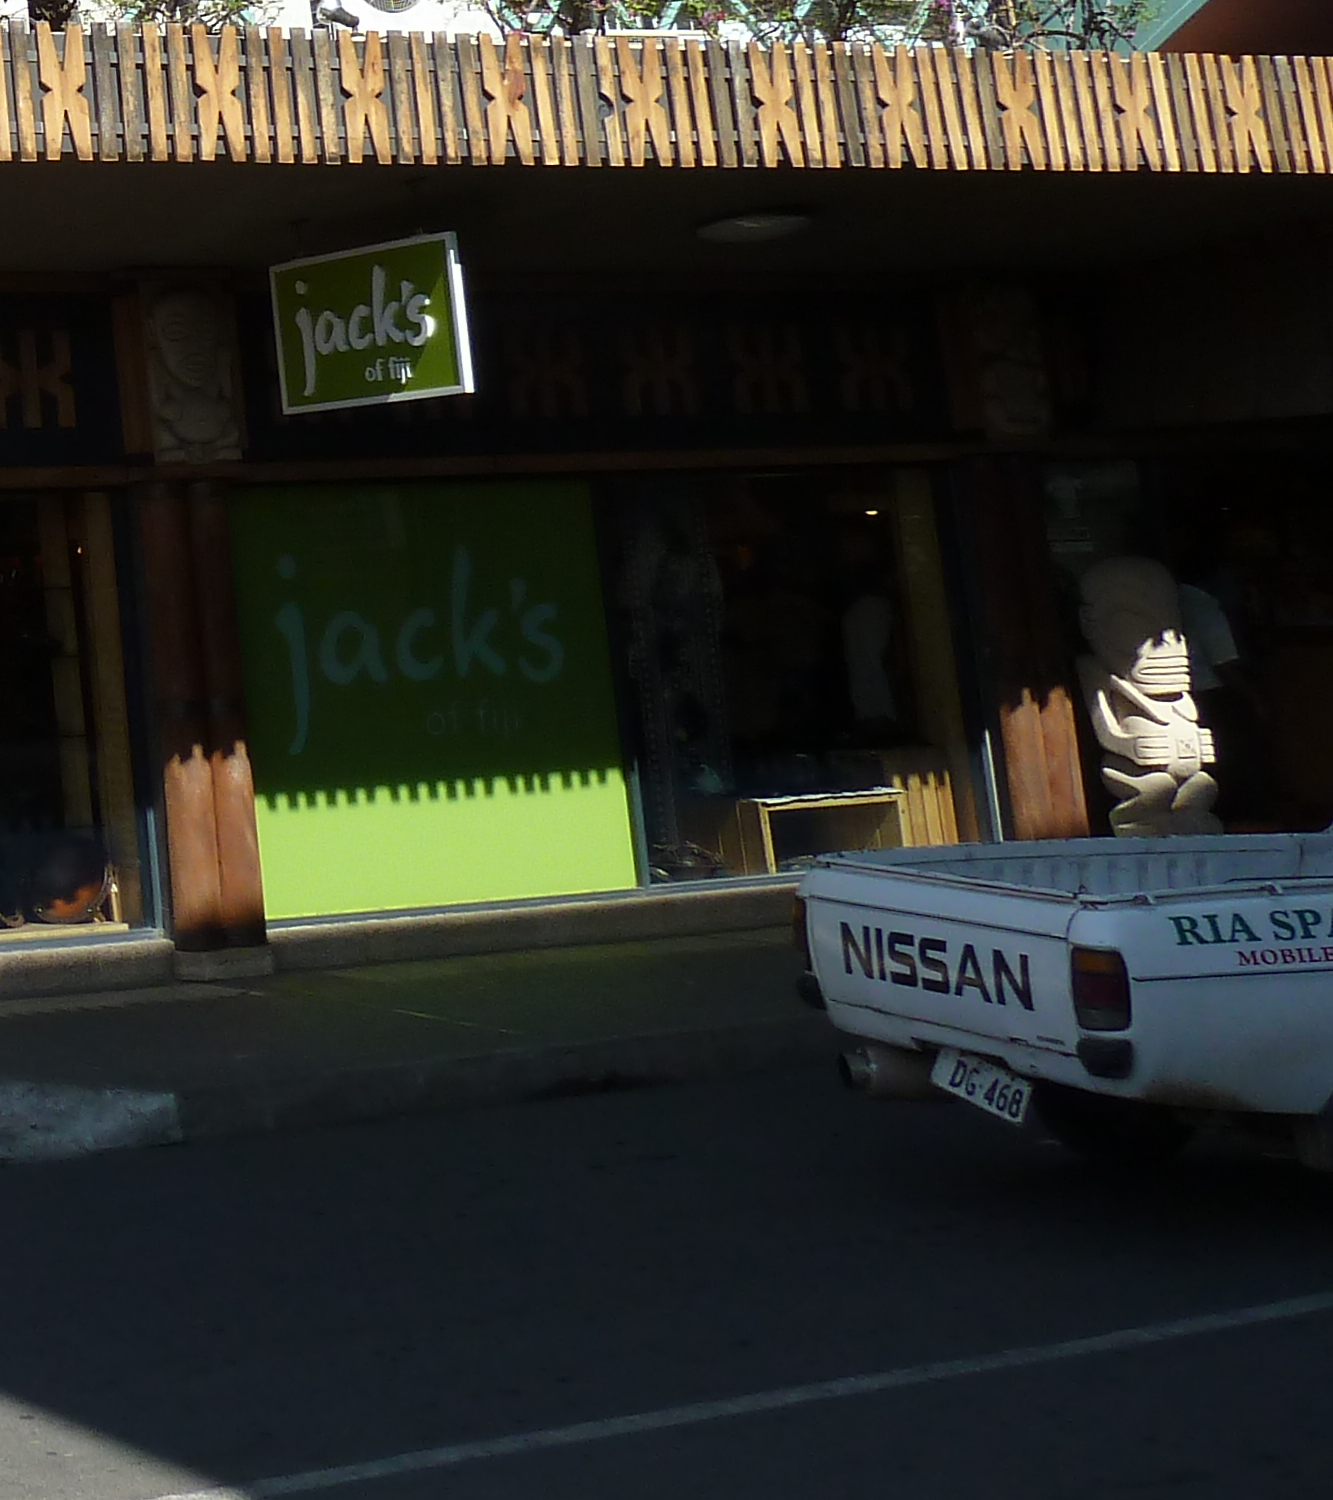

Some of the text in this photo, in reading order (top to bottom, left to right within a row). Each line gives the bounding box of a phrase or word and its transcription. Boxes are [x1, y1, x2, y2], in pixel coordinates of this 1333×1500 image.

[294, 264, 433, 397] jack's
[364, 355, 414, 386] of fiji
[272, 542, 567, 756] jack's
[1167, 908, 1333, 946] RIA SP
[1235, 946, 1333, 967] MOBILE
[839, 920, 1036, 1013] NISSAN
